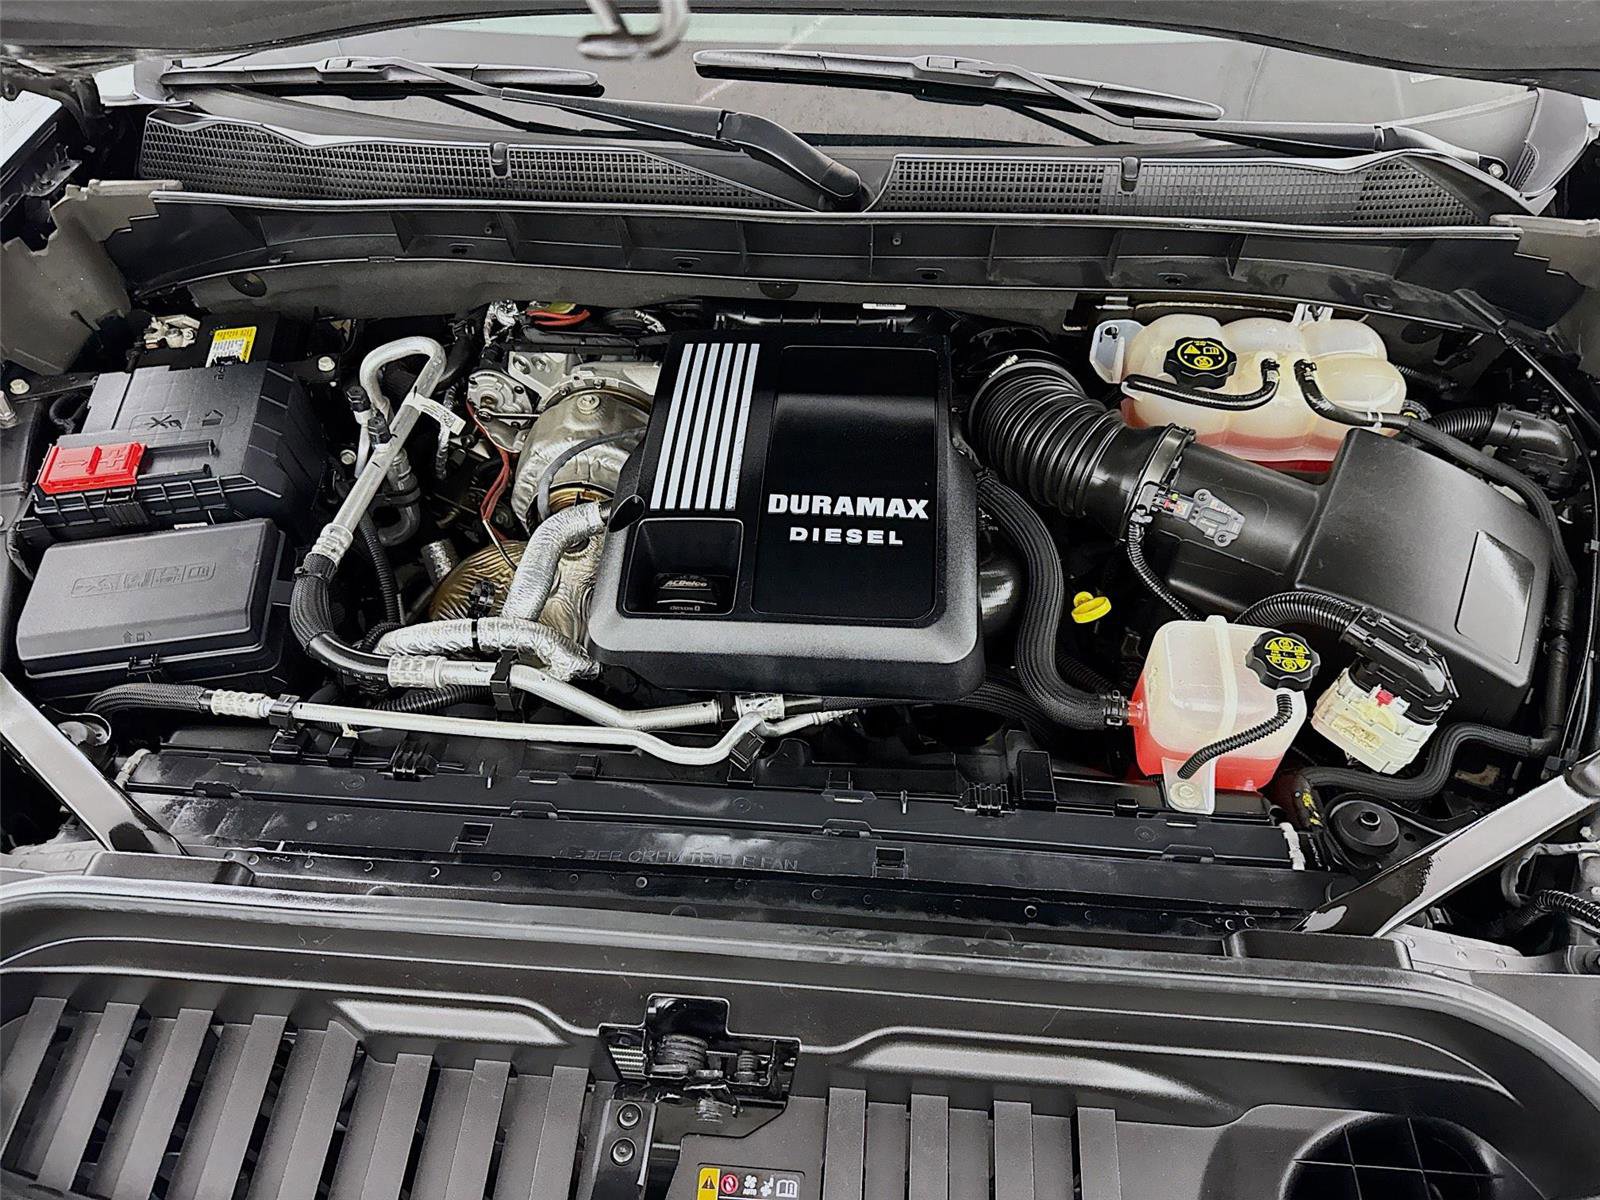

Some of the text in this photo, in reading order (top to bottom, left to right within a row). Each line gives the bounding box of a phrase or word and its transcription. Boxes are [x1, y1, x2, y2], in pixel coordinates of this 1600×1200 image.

[768, 493, 929, 520] DURAMAX
[789, 526, 904, 546] DIESEL
[664, 580, 708, 588] ACDelco
